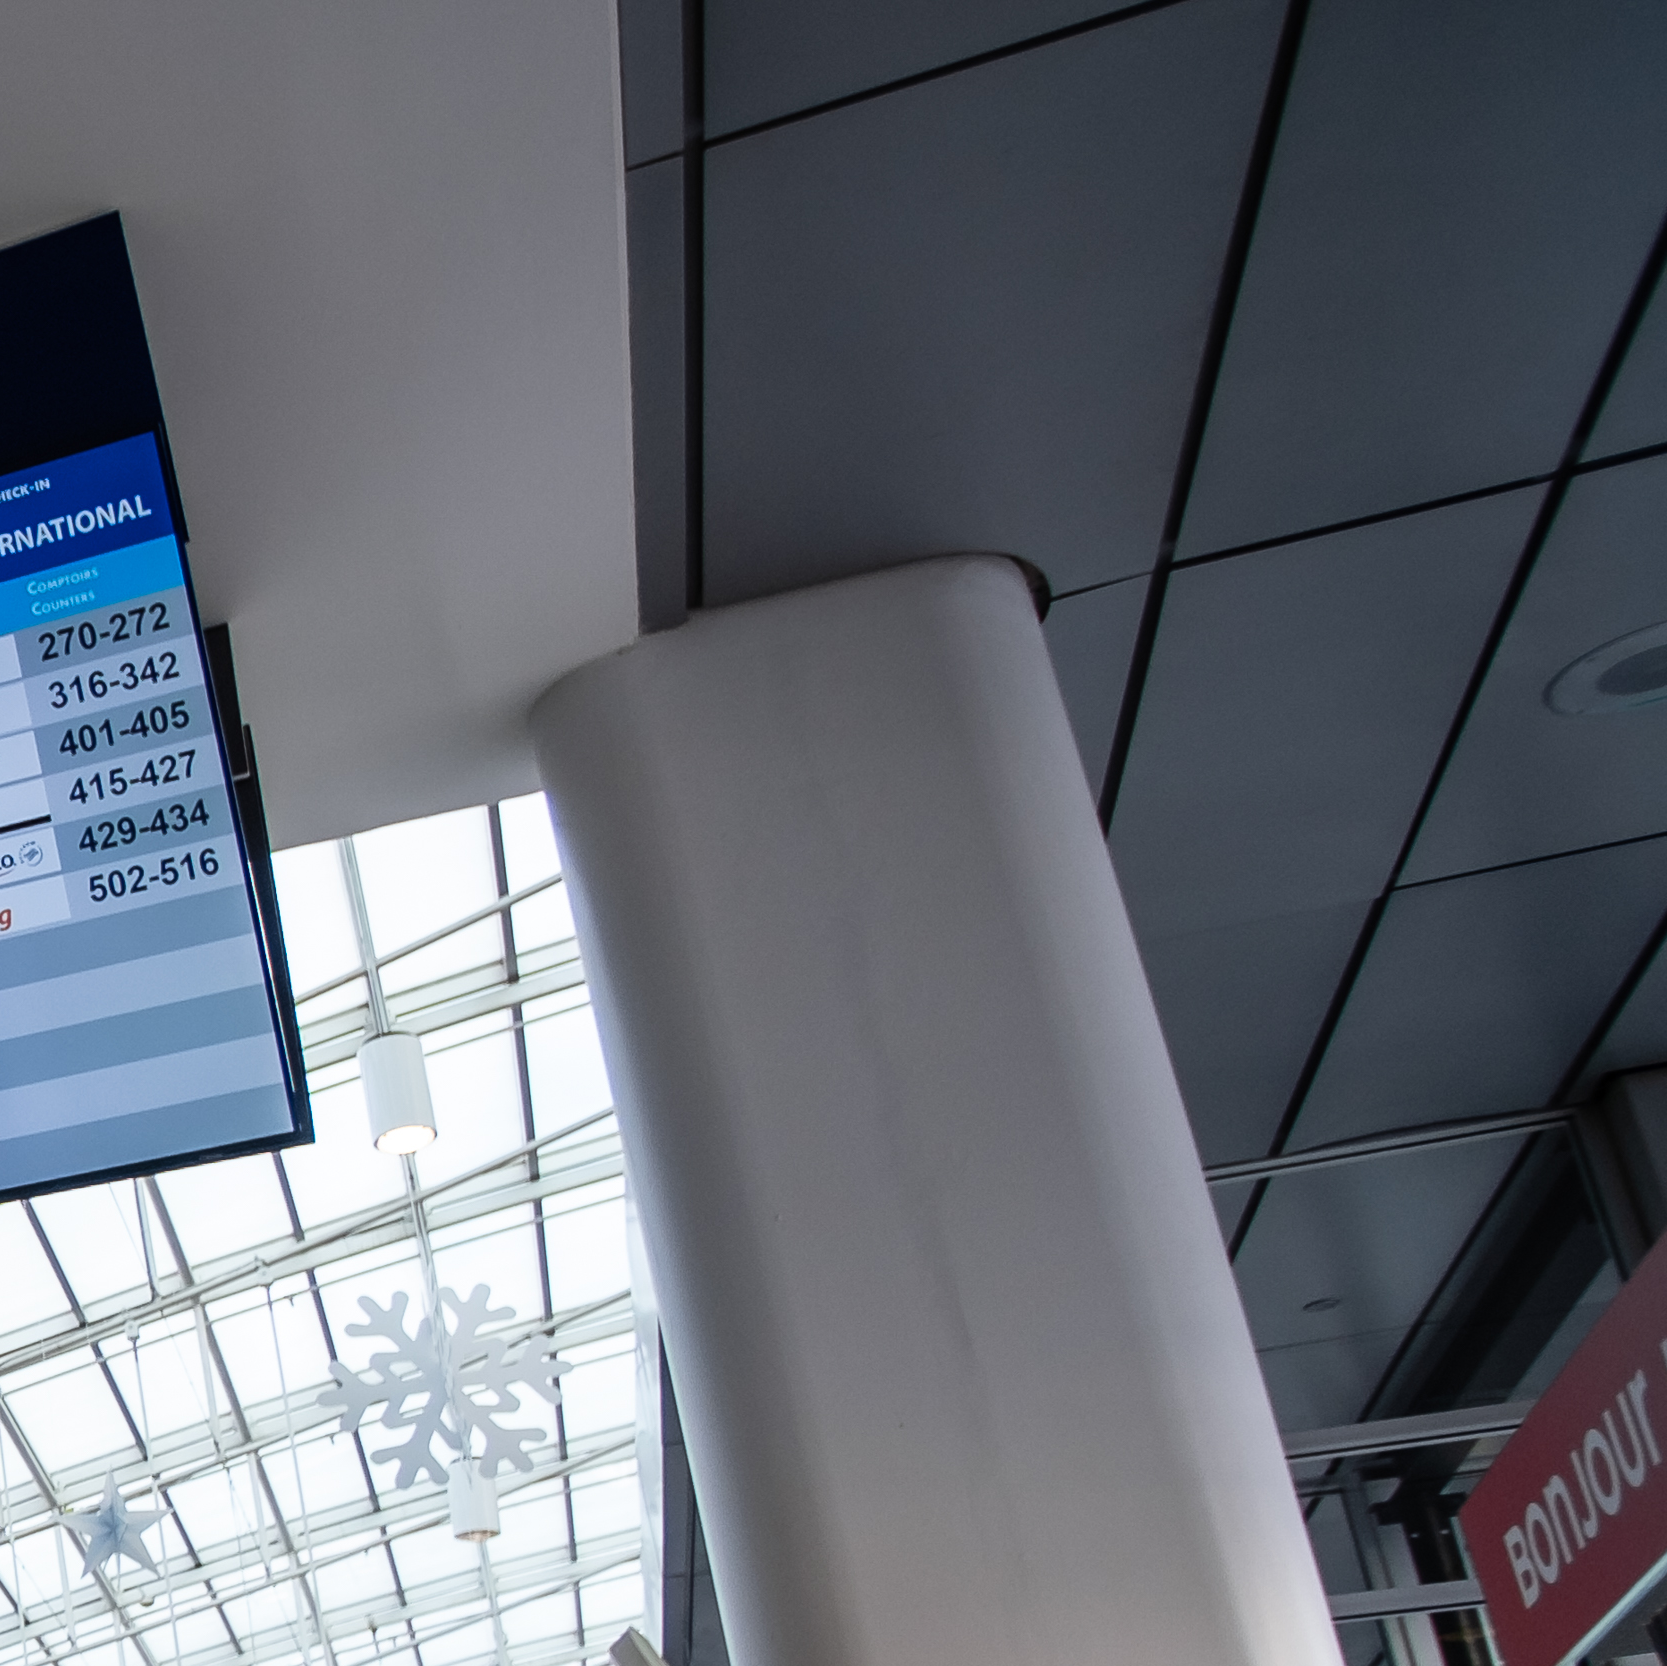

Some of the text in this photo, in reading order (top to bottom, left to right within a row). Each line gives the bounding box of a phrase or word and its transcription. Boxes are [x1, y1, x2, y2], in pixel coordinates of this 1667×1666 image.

[26, 567, 99, 596] COMPTOIRS
[31, 591, 95, 618] COUNTERS
[38, 601, 171, 662] 270-272
[48, 651, 181, 710] 316-342
[58, 701, 190, 757] 401-405
[68, 749, 197, 806] 415-427
[78, 799, 210, 854] 429-434
[88, 848, 219, 902] 502-516
